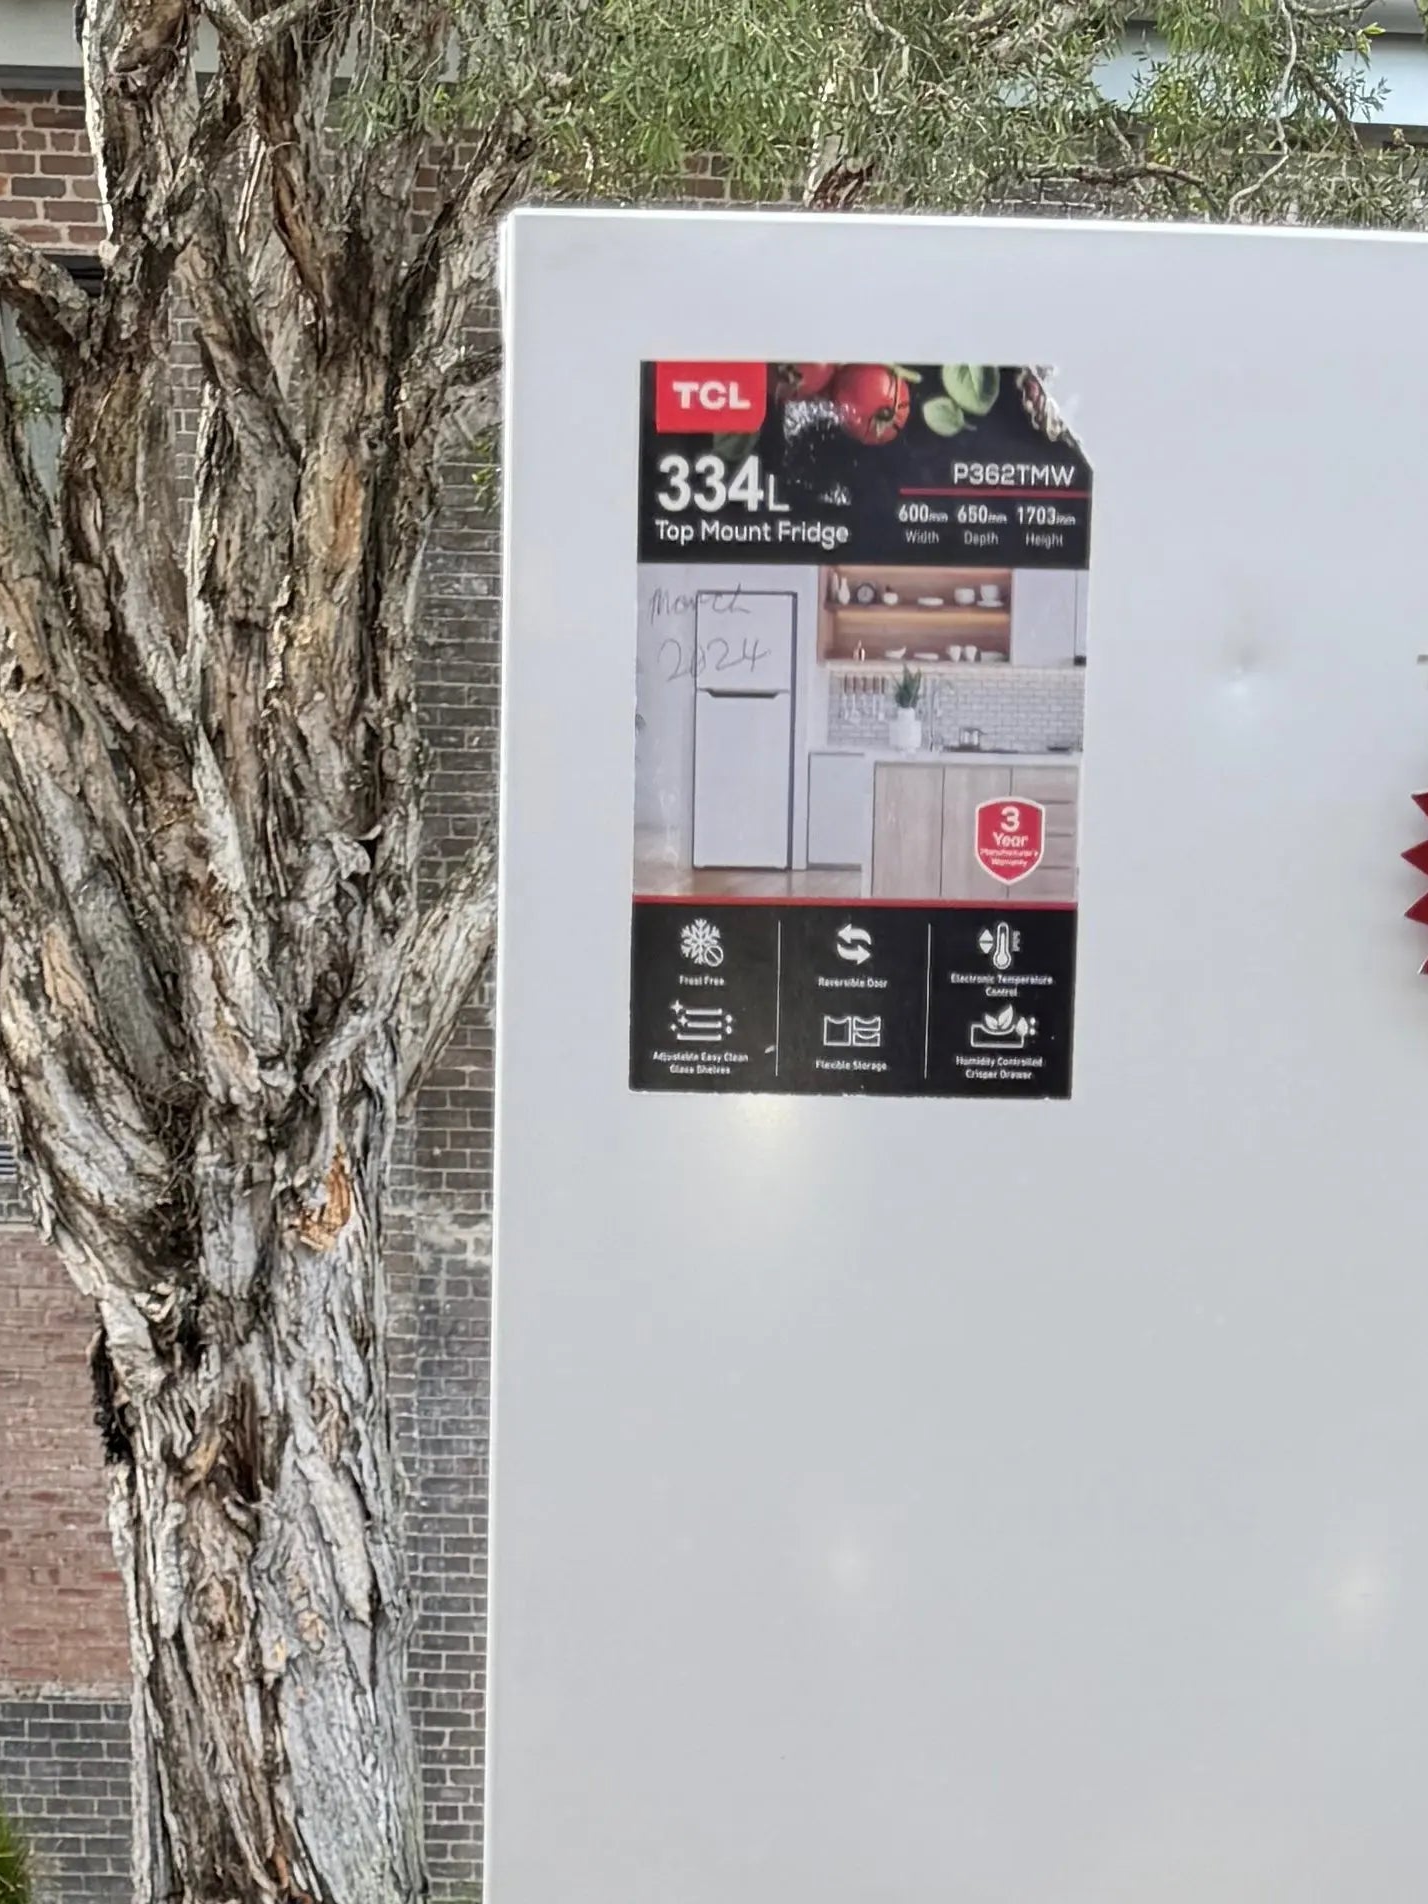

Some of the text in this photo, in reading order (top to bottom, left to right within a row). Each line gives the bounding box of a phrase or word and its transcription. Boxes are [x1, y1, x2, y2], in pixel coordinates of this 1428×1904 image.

[672, 381, 752, 410] TCL
[657, 454, 790, 513] 334L
[954, 462, 1075, 487] P362TMW
[898, 503, 949, 523] 600mm
[655, 519, 849, 551] Top Mount Fridge
[905, 529, 1064, 550] Width Depth Height
[657, 637, 772, 682] 2024
[1000, 805, 1021, 833] 3
[992, 831, 1030, 847] Year
[704, 975, 725, 986] Free
[853, 1060, 888, 1072] Storage
